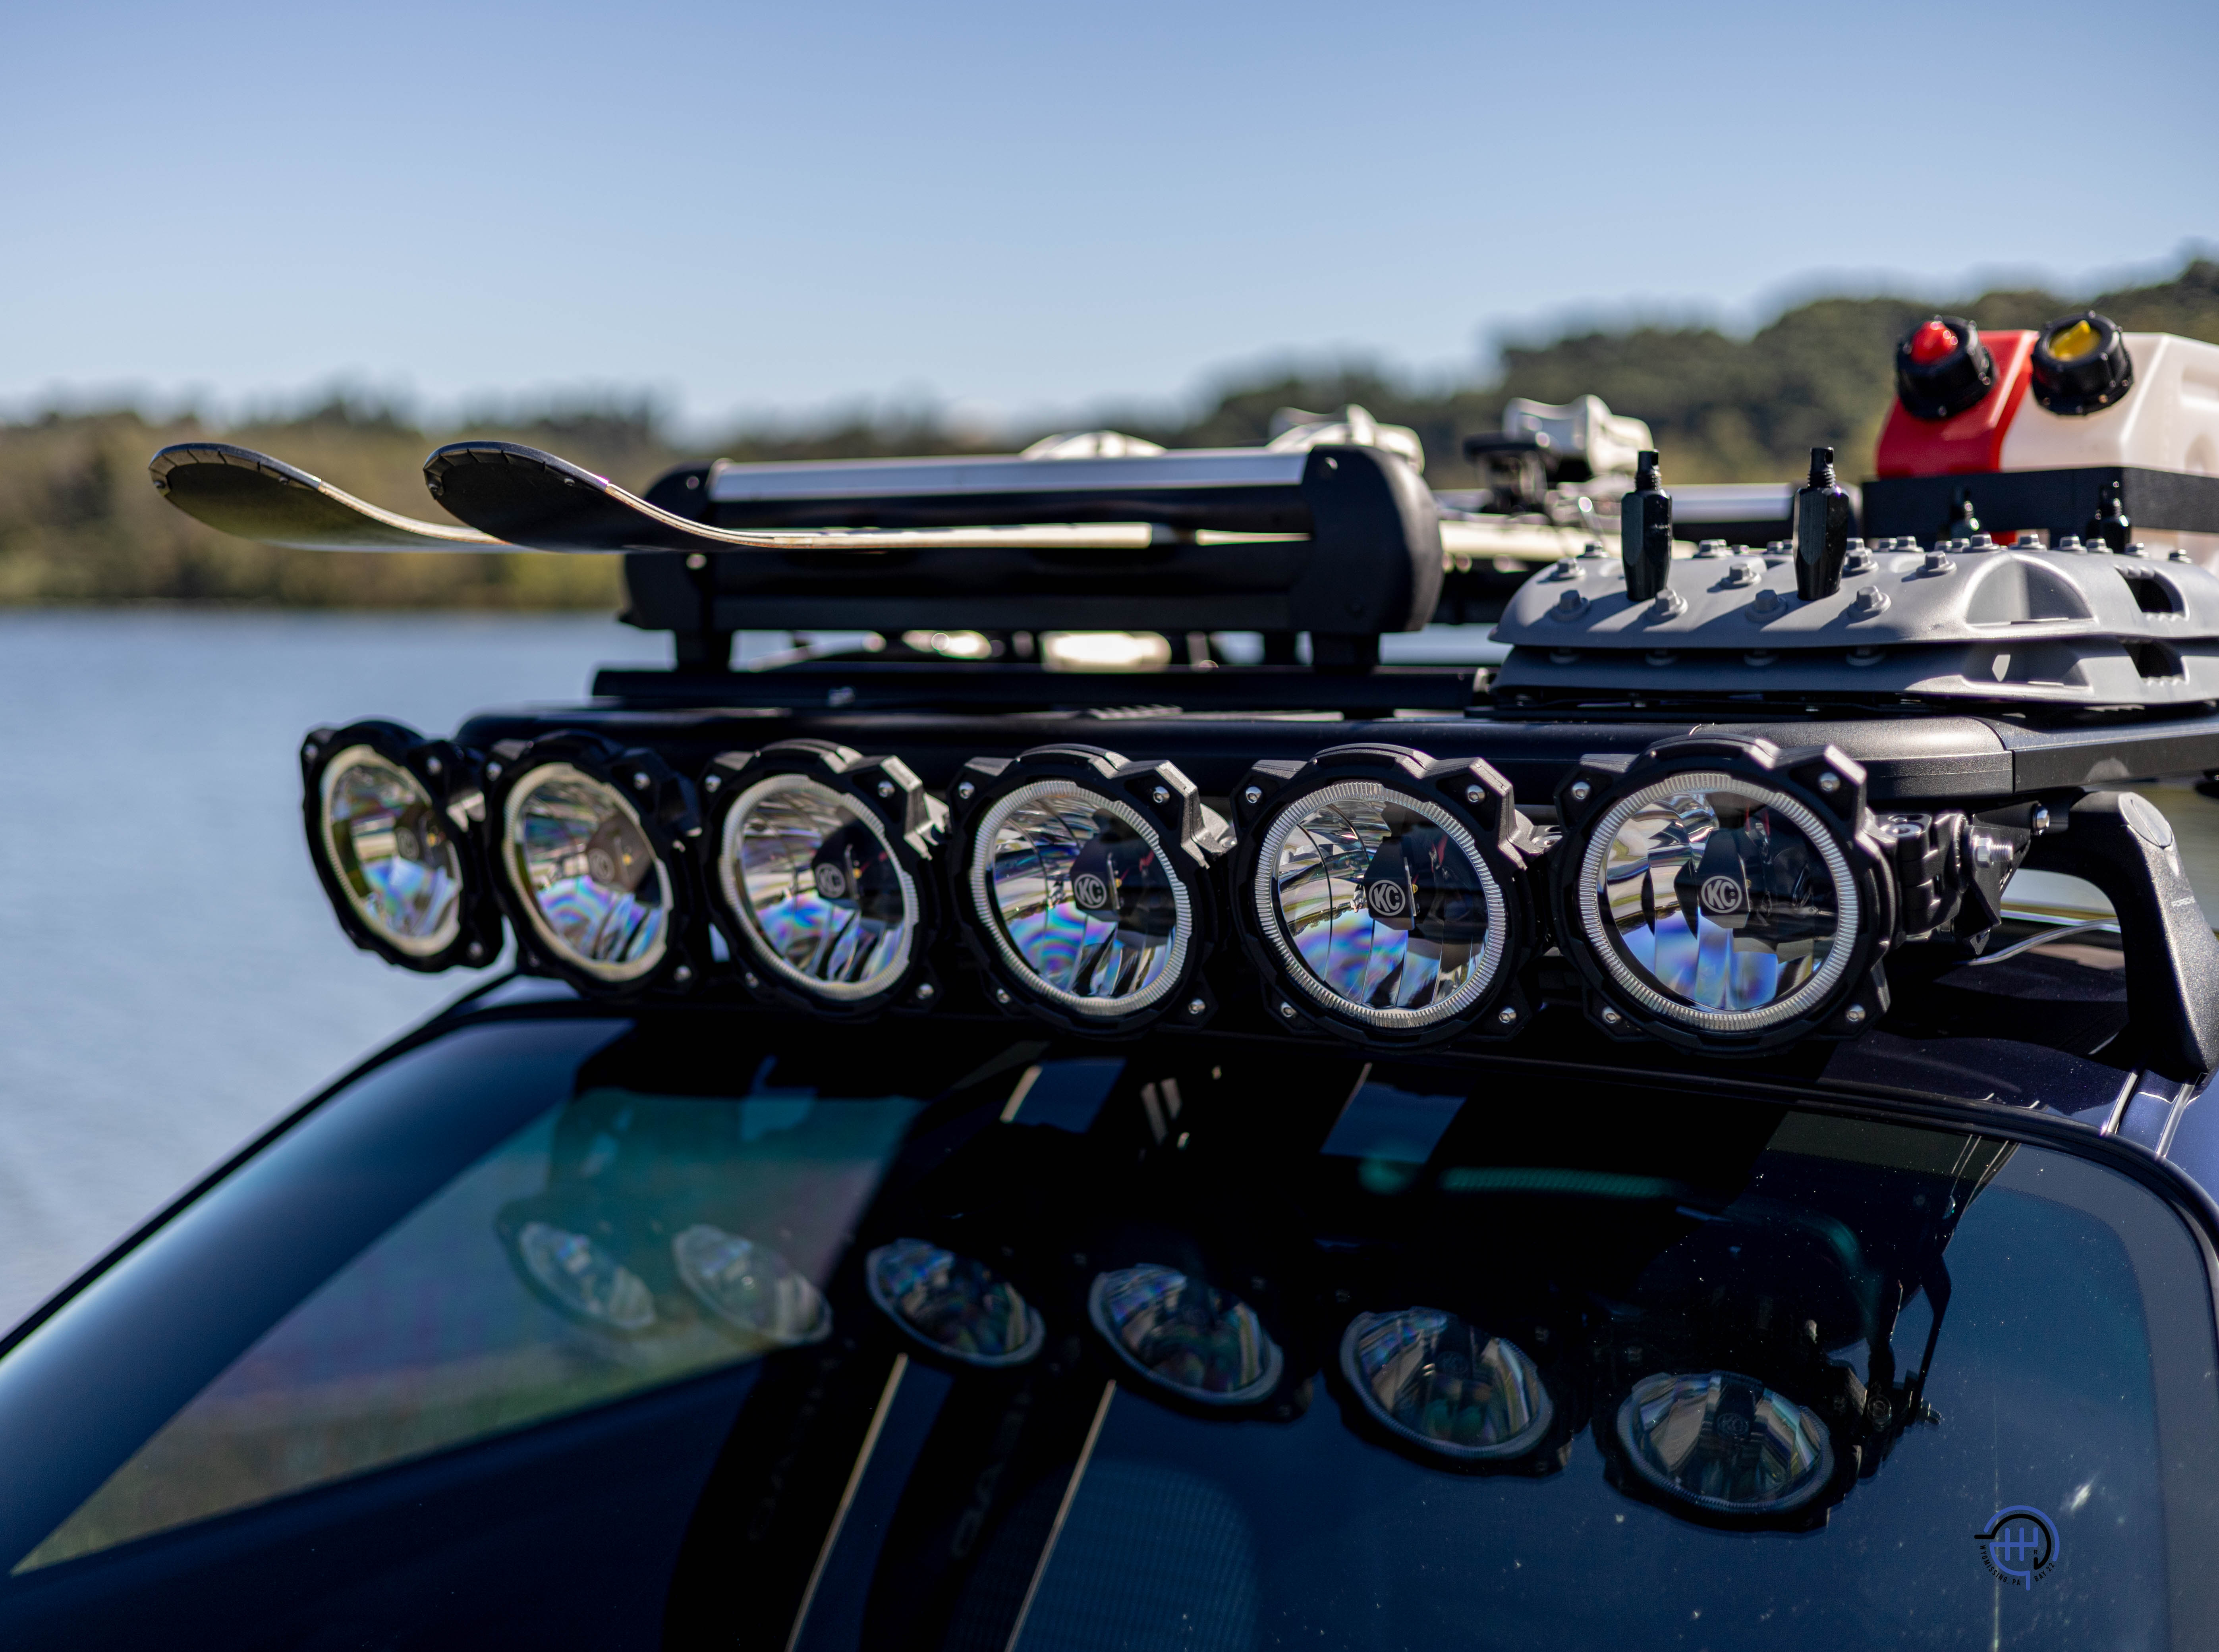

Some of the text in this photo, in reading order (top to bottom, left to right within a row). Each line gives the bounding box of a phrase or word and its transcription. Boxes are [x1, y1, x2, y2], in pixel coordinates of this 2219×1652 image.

[1078, 878, 1102, 904] KC
[1373, 884, 1400, 912] KC
[1706, 880, 1736, 909] KC
